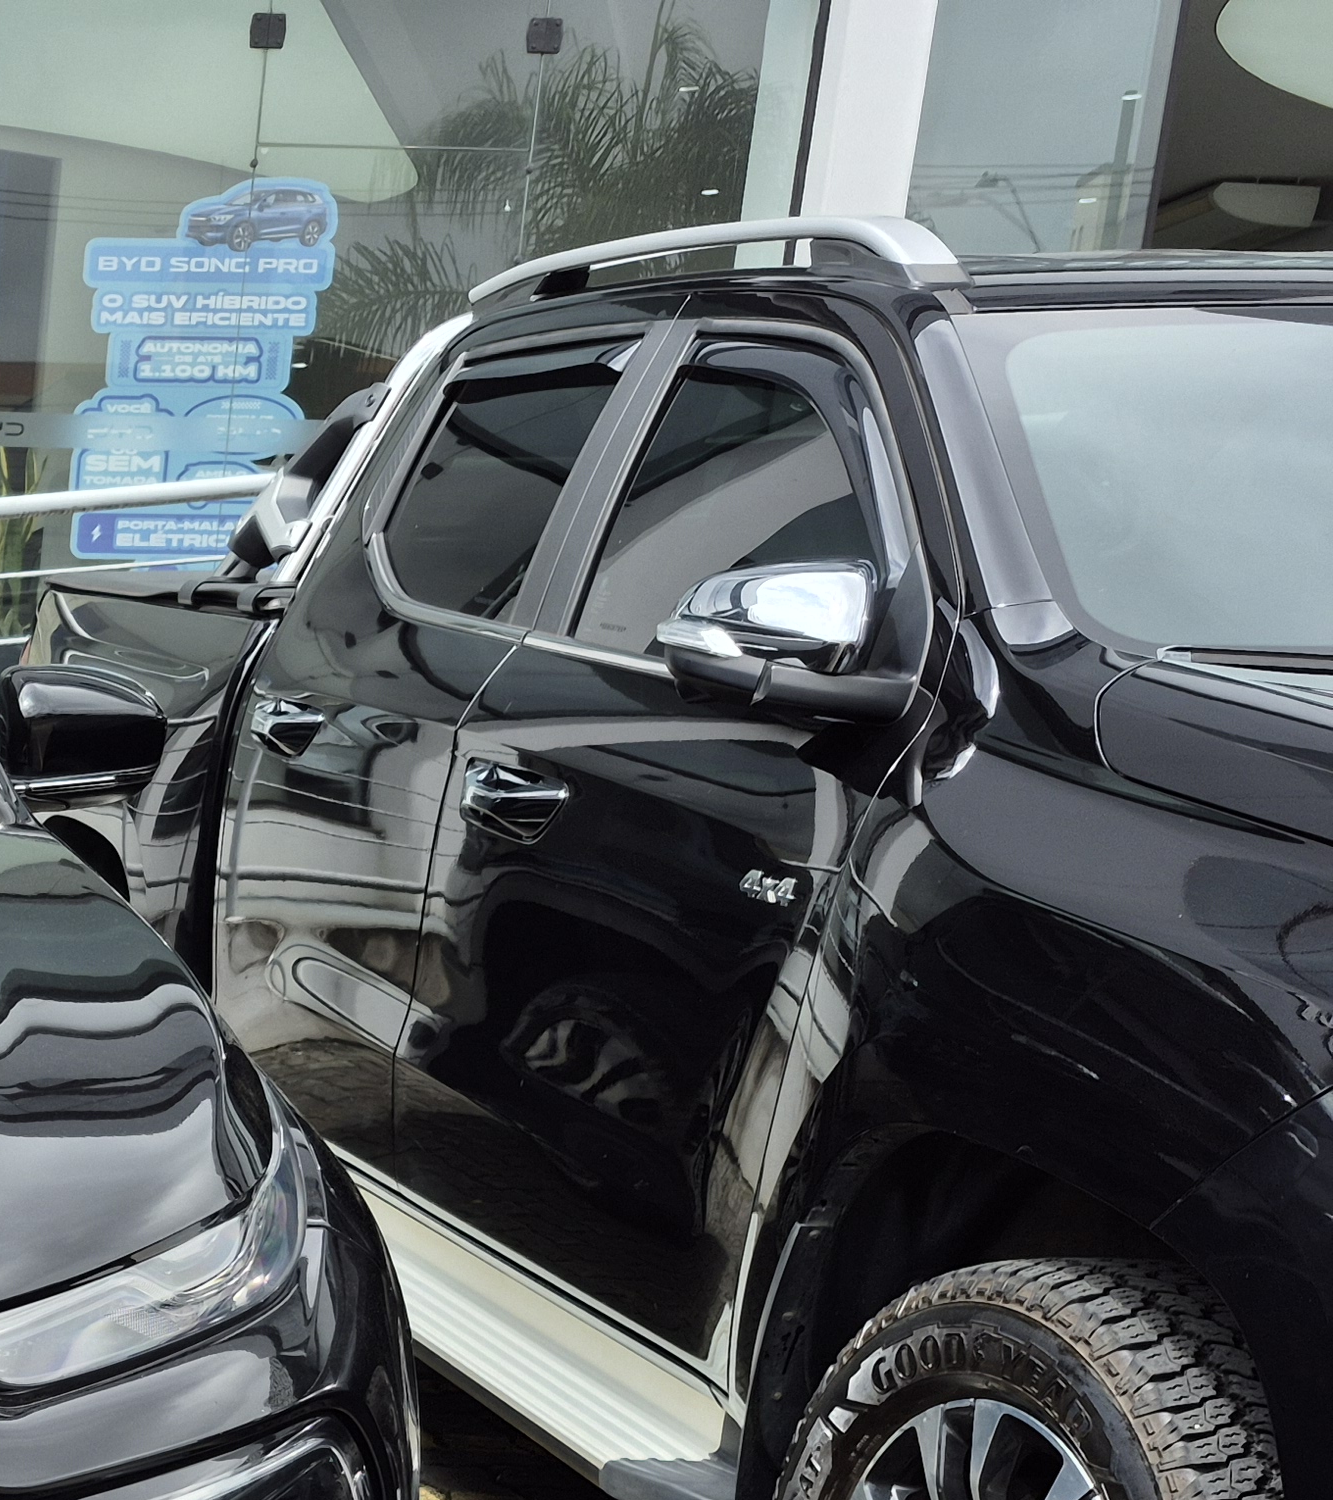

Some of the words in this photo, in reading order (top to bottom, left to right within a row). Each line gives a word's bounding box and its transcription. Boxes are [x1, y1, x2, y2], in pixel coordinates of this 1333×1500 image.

[98, 256, 161, 272] BYD
[169, 257, 250, 273] SONG
[258, 258, 318, 274] PRO
[102, 293, 123, 308] O
[131, 294, 188, 309] SUV
[196, 291, 307, 310] HÍBRIDO
[100, 311, 165, 325] MAIS
[174, 312, 306, 327] EFICIENTE
[143, 342, 257, 354] AUTONOMIA
[139, 365, 210, 377] 1.100
[217, 365, 256, 378] KM
[106, 403, 152, 414] VOCÊ
[85, 454, 161, 472] SEM
[83, 475, 158, 485] TOMADA
[117, 520, 238, 532] PORTA-MALA
